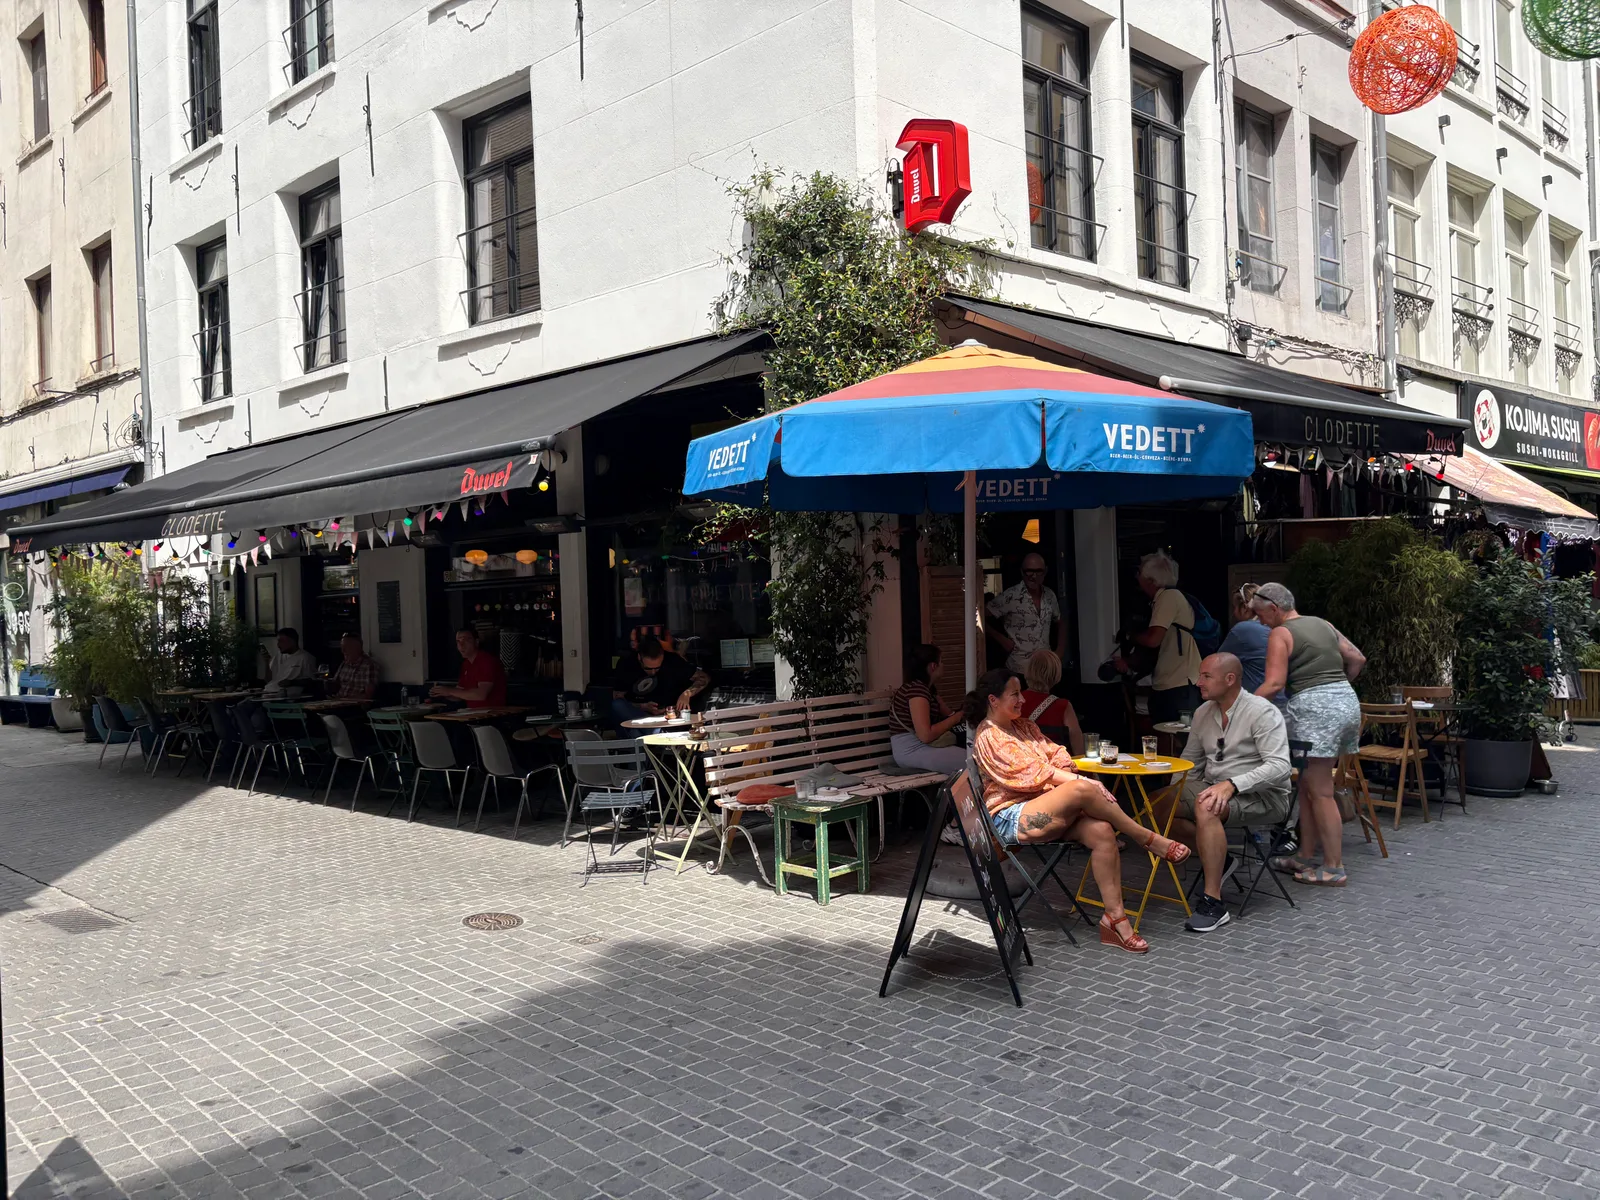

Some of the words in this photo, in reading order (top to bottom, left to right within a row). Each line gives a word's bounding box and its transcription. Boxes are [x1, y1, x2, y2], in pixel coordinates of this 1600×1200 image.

[910, 168, 920, 204] Duvel
[1102, 422, 1196, 454] VEDETT
[1304, 415, 1380, 448] CLODETTE
[1504, 403, 1551, 438] KOJIMA
[1550, 414, 1581, 443] SUSHI
[707, 439, 751, 471] VEDETT
[1426, 428, 1457, 452] Duvel
[461, 461, 513, 495] Duvel
[161, 510, 227, 537] CLODETTE
